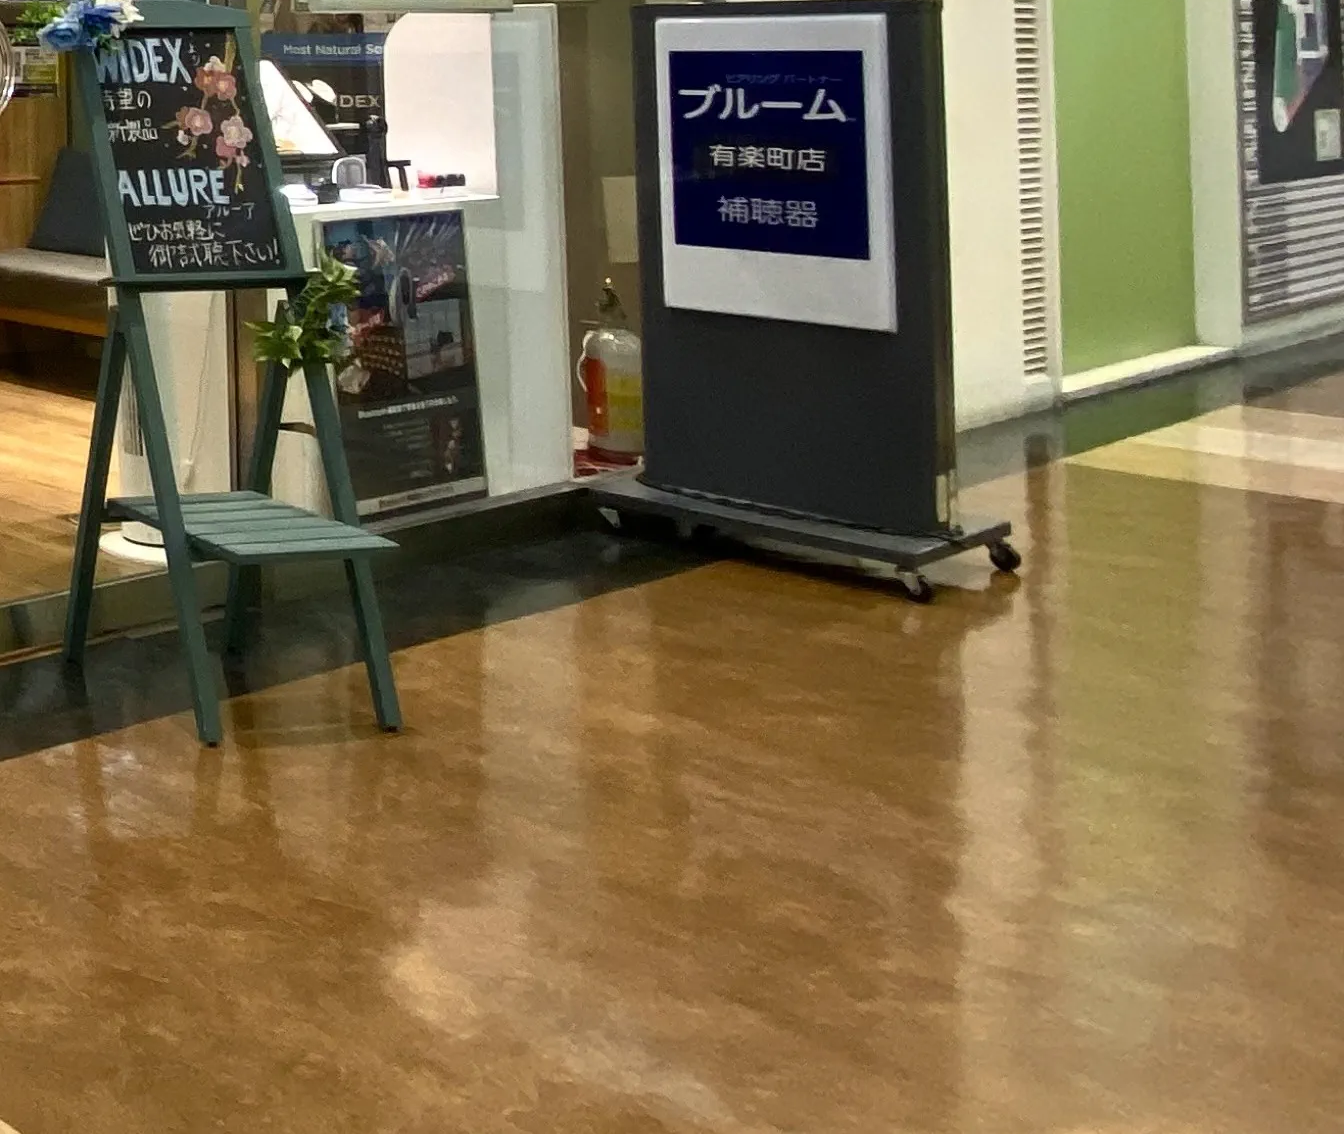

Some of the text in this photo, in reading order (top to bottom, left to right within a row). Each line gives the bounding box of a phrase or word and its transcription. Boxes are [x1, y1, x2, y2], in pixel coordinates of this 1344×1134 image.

[283, 44, 313, 55] Most
[315, 45, 362, 55] Natural
[678, 83, 848, 123] ブルーム
[709, 144, 827, 173] 有楽町店
[117, 167, 231, 208] ALLURE
[717, 195, 819, 229] 補聴器
